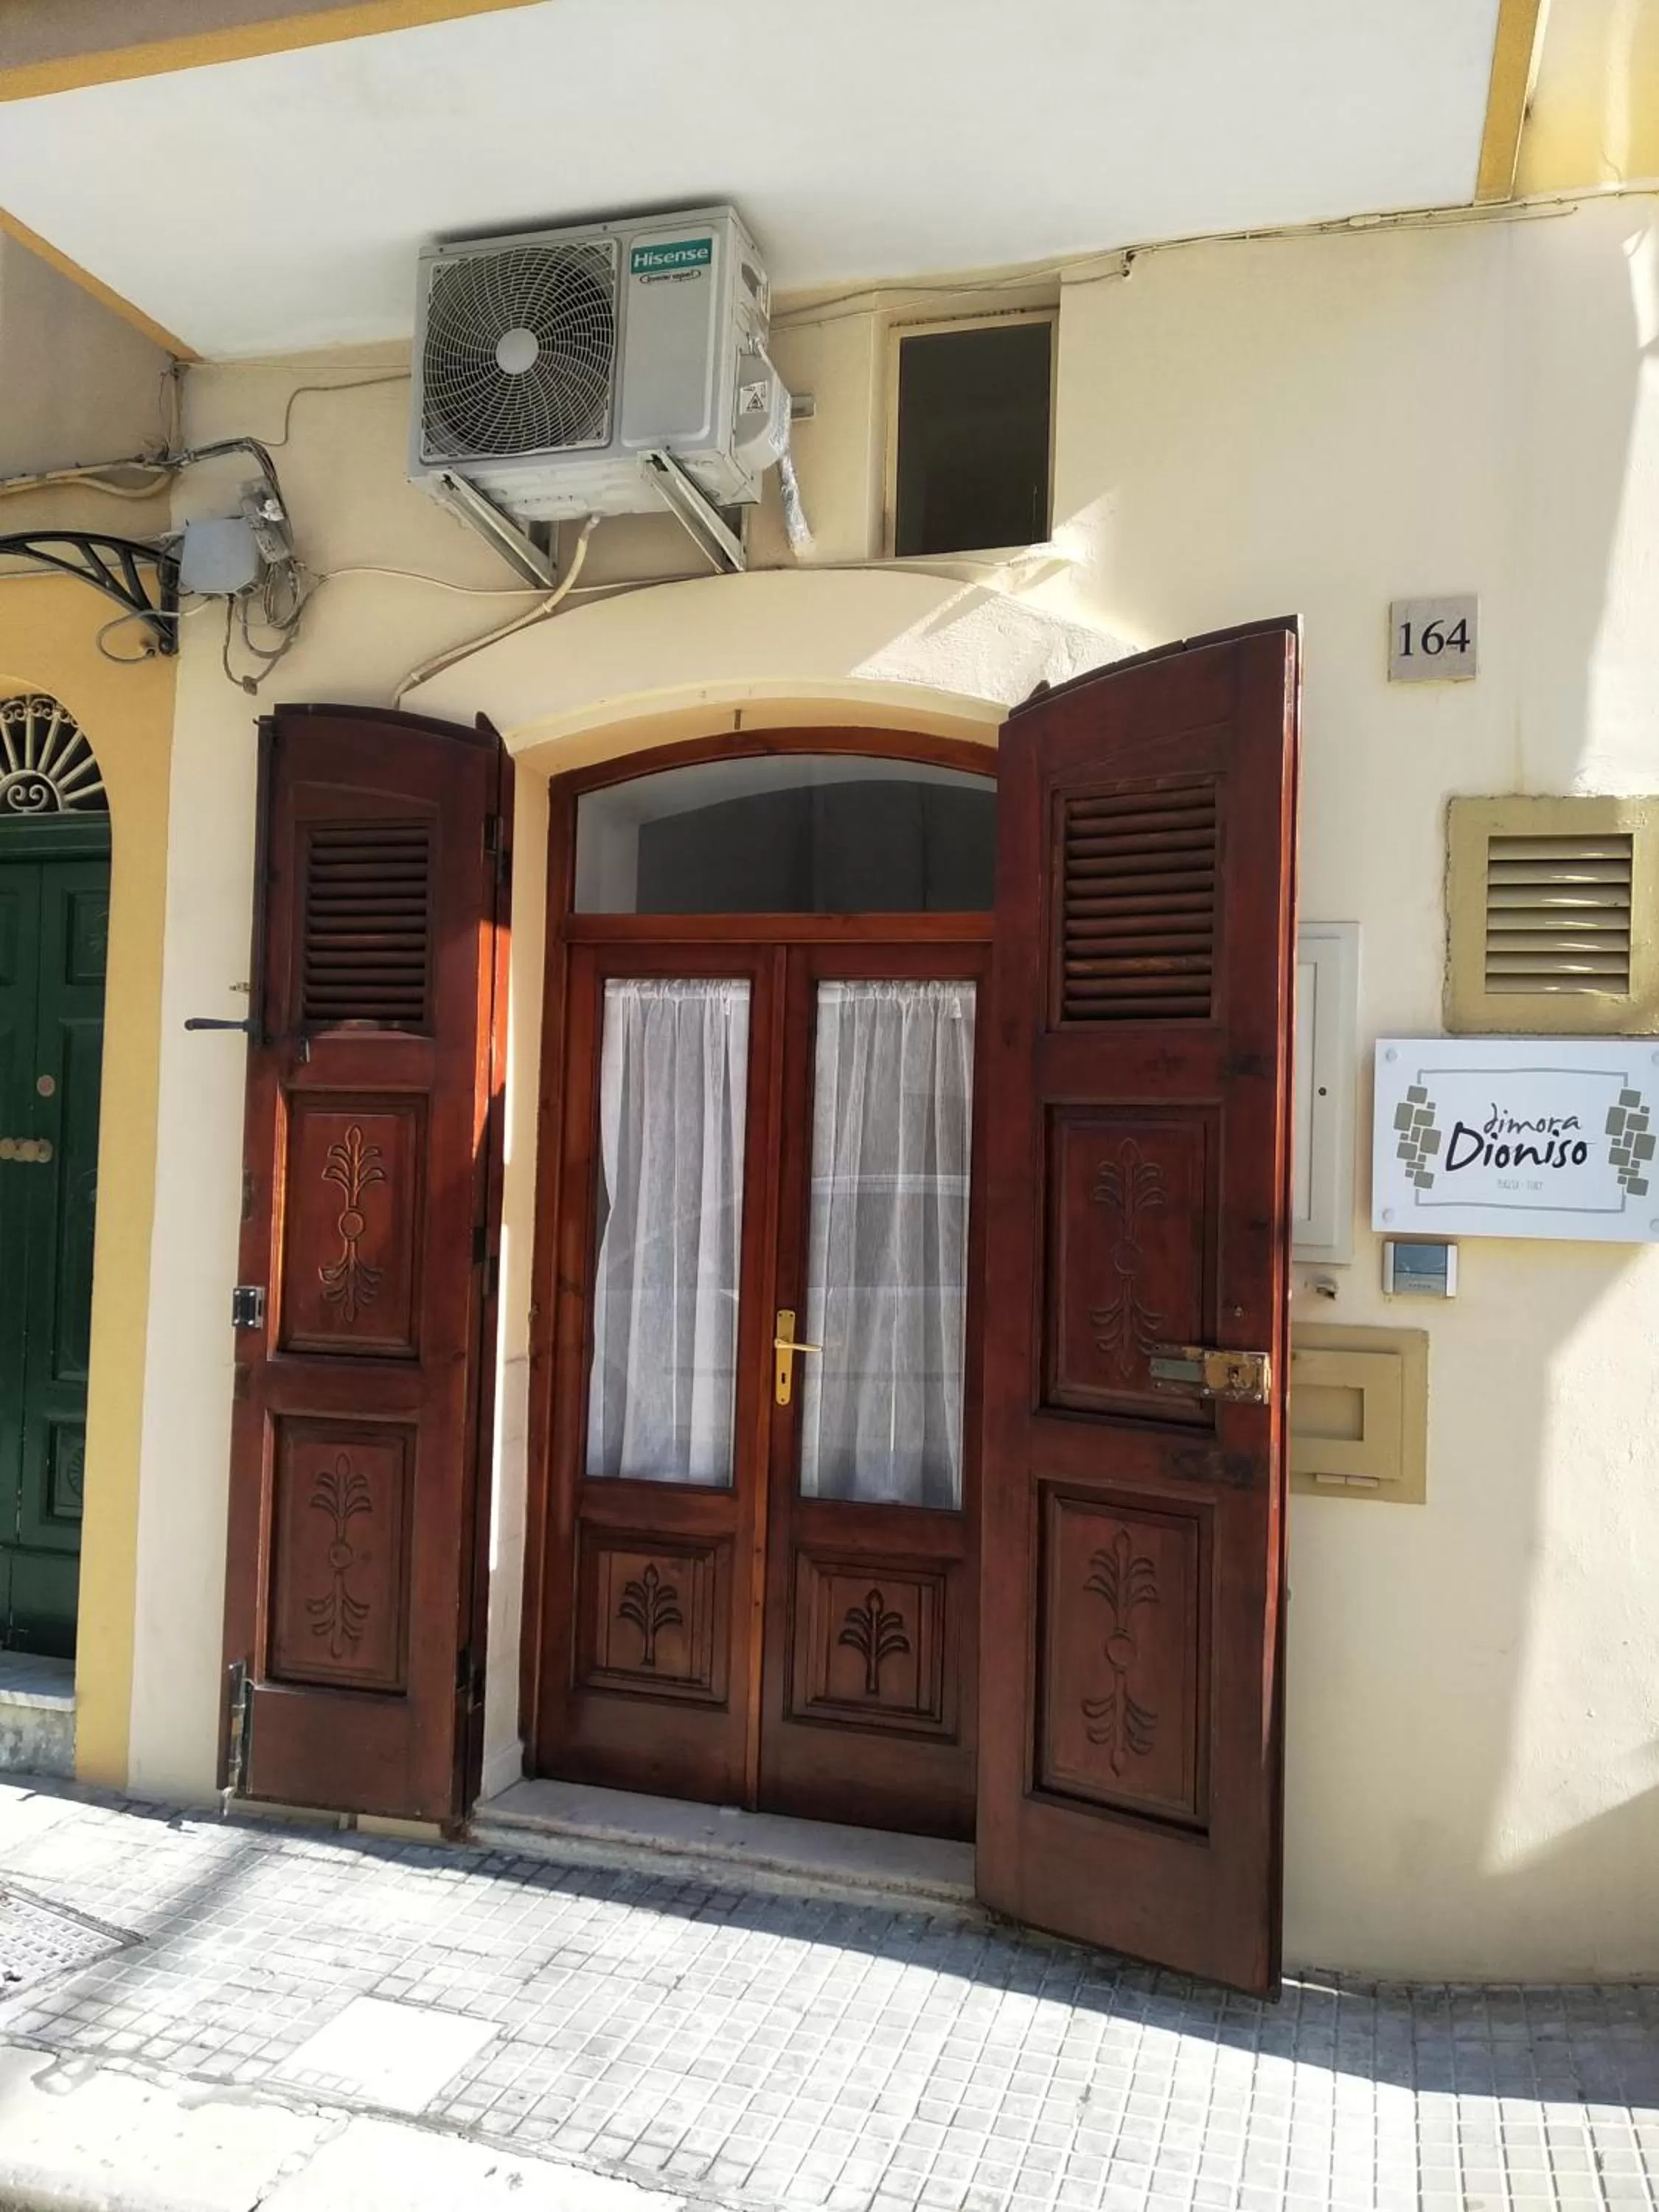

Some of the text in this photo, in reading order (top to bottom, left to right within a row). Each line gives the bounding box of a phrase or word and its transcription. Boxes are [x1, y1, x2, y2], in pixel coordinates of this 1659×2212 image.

[634, 247, 709, 268] Hisense
[1399, 618, 1470, 656] 164
[1483, 1103, 1582, 1133] dimora
[1445, 1121, 1588, 1171] Dioniso
